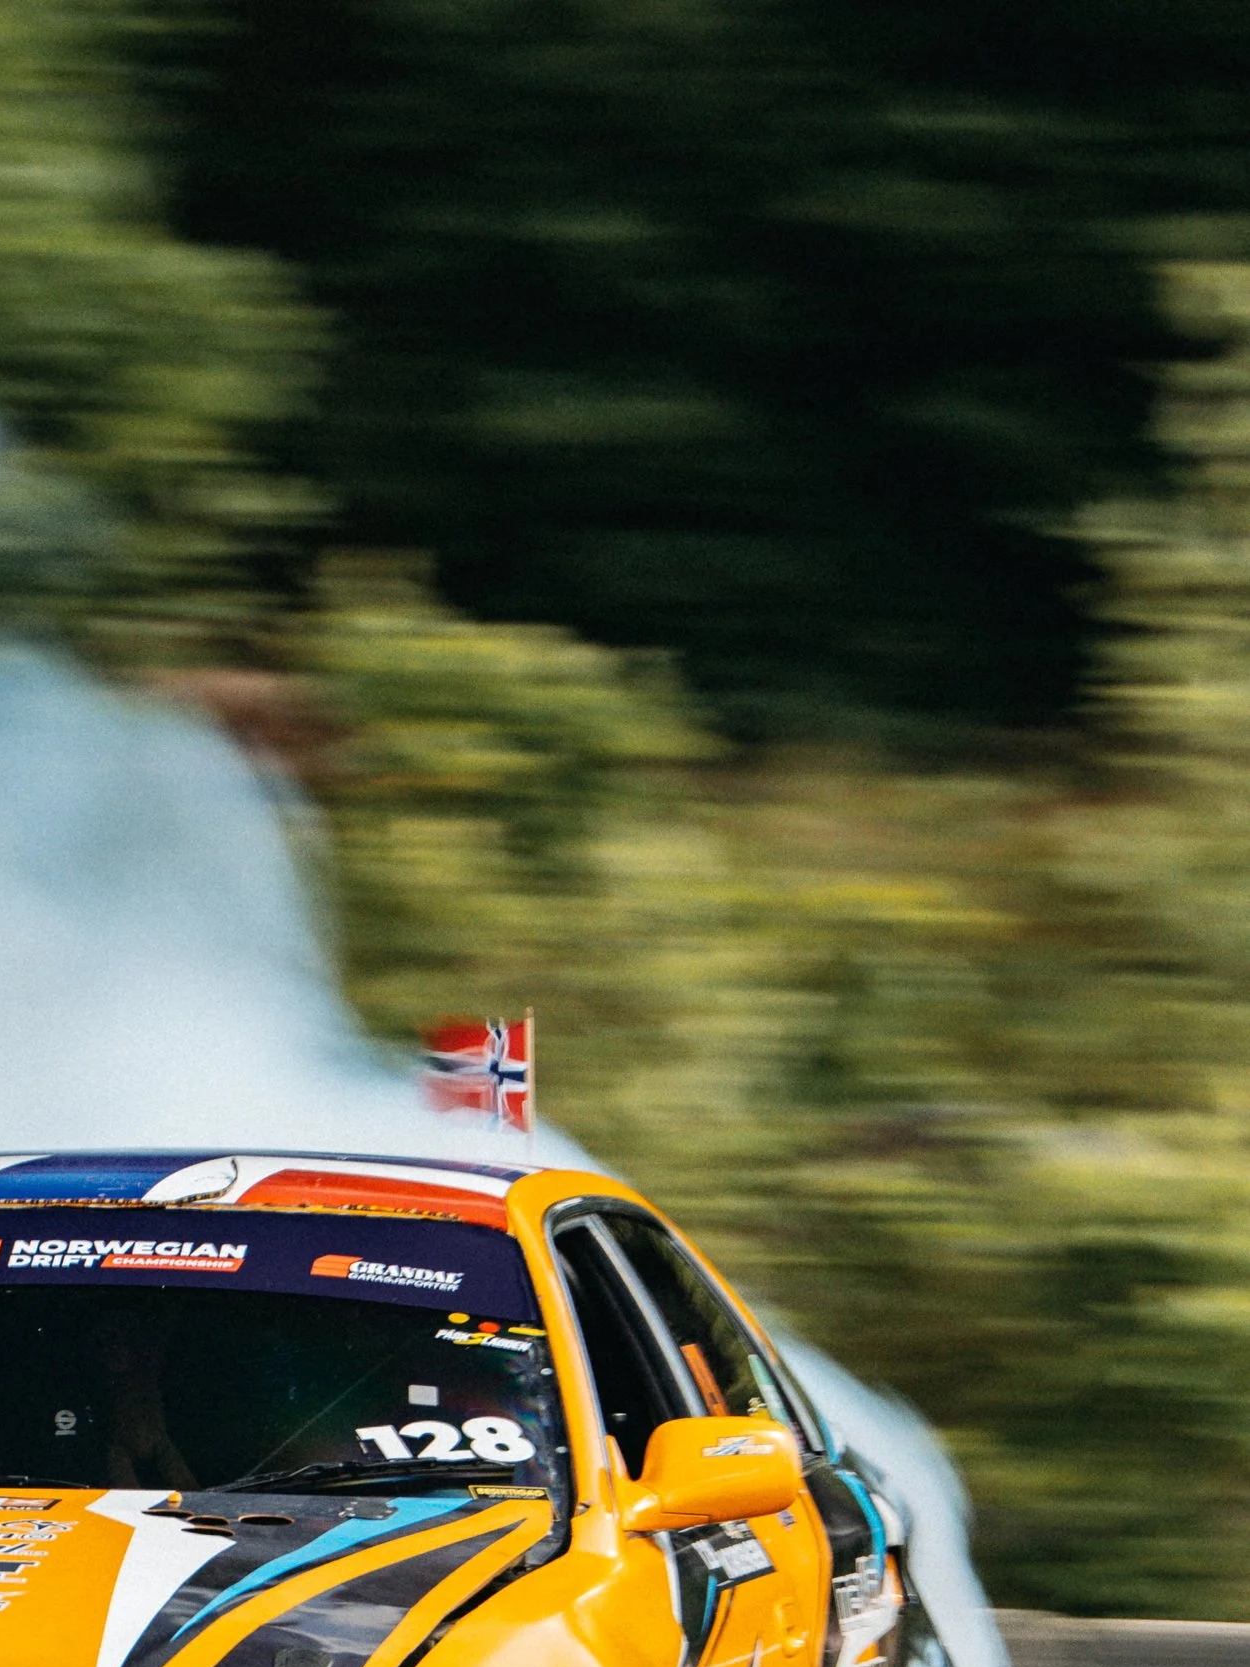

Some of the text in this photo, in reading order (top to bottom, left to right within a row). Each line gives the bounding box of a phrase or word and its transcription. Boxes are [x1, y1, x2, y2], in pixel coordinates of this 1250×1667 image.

[11, 1239, 248, 1259] NORWEGIAN
[7, 1254, 235, 1269] DRIFT CHAMPIONSHIP
[354, 1416, 537, 1463] 128
